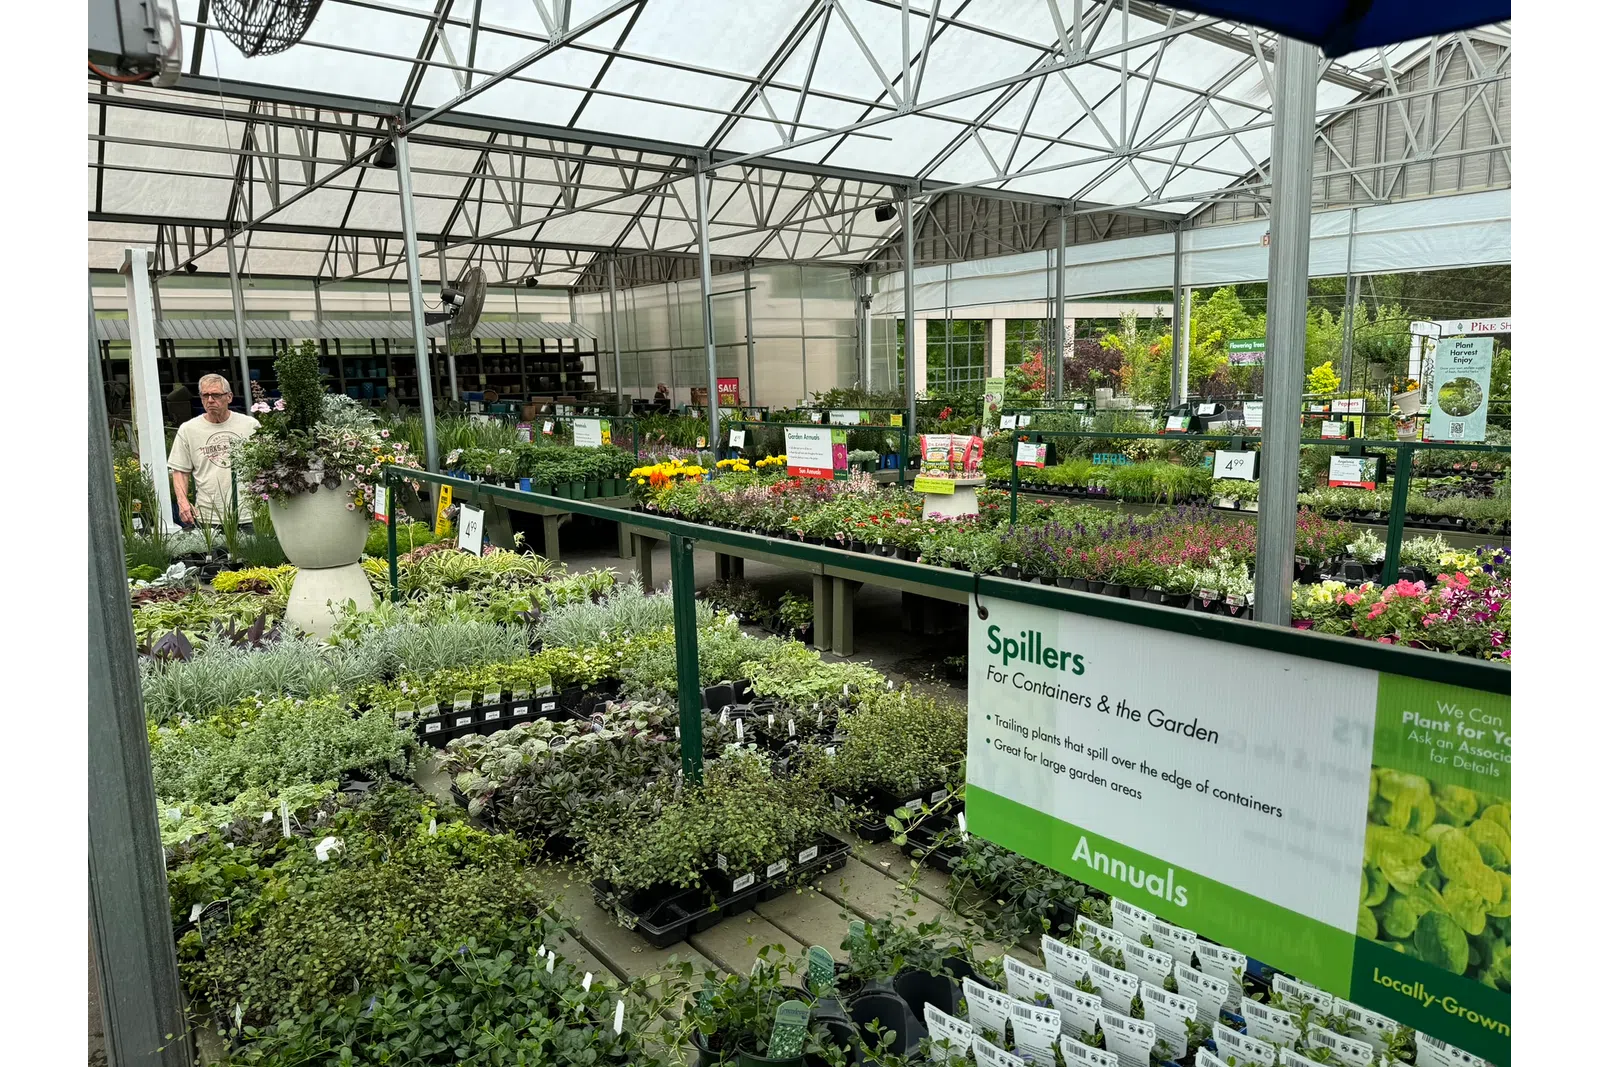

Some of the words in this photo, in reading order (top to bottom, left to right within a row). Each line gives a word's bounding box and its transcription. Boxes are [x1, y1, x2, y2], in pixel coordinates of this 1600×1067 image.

[718, 384, 736, 392] SALE
[987, 625, 1085, 676] Spillers
[987, 665, 1008, 684] For
[1012, 672, 1092, 708] Containers
[1097, 695, 1110, 714] &
[1116, 699, 1141, 722] the
[1148, 709, 1219, 744] Garden
[1402, 711, 1450, 733] Plant
[1457, 722, 1486, 740] for
[1437, 701, 1464, 718] We
[1469, 708, 1502, 727] Can
[1408, 730, 1432, 745] Ask
[1436, 740, 1453, 749] an
[1430, 748, 1448, 764] for
[1453, 755, 1500, 777] Details
[994, 739, 1021, 757] Great
[1024, 746, 1037, 762] for
[1040, 752, 1066, 774] large
[1069, 770, 1107, 788] garden
[1110, 781, 1142, 800] areas
[995, 714, 1029, 739] Trailing
[1032, 727, 1060, 746] plants
[1064, 736, 1084, 754] that
[1087, 747, 1108, 761] spill
[1112, 755, 1136, 771] over
[1140, 760, 1158, 777] the
[1161, 770, 1192, 790] edge
[1196, 780, 1209, 794] of
[1213, 788, 1282, 818] containers
[1071, 836, 1188, 907] Annuals
[1373, 967, 1510, 1037] Locally-Grown
